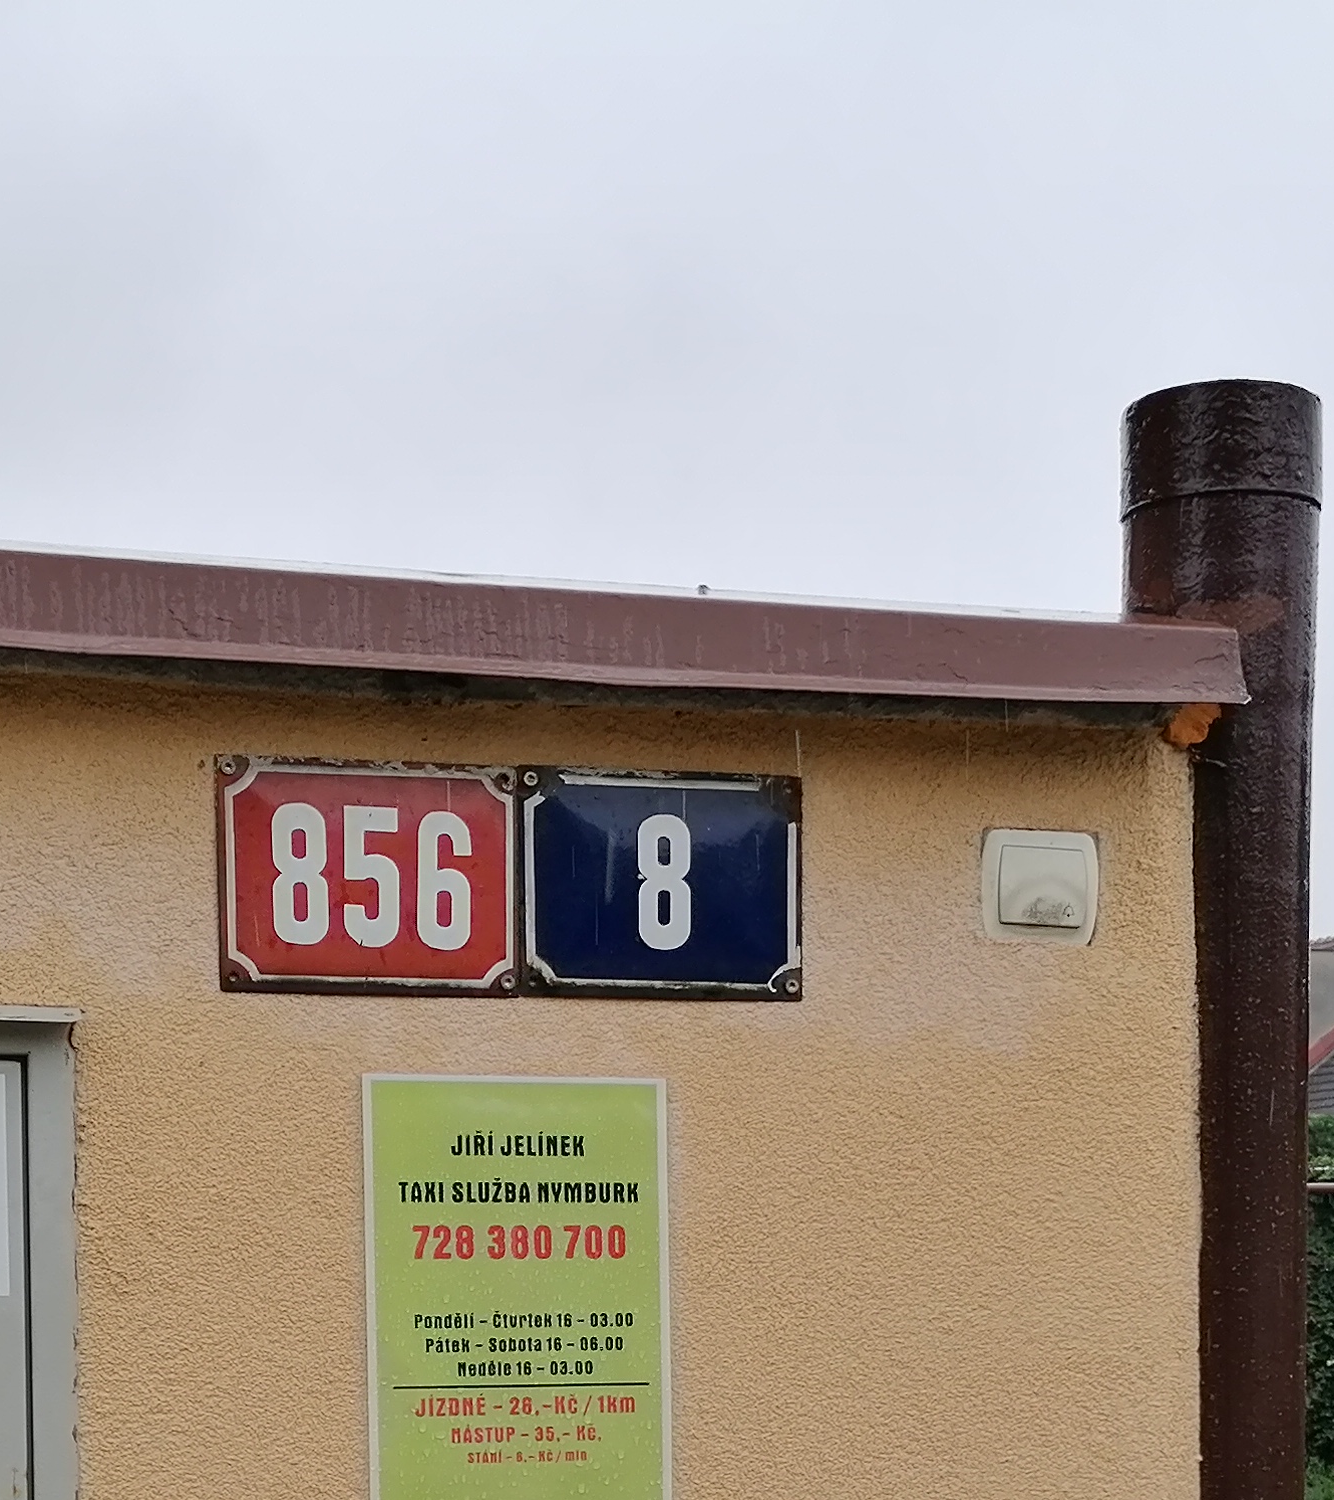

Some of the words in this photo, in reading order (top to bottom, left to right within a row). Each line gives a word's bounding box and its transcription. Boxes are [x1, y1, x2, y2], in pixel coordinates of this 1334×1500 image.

[271, 802, 473, 951] 856
[637, 814, 692, 951] 8
[450, 1130, 494, 1157] JIŘÍ
[500, 1131, 585, 1157] JELÍNEK
[398, 1181, 444, 1203] TAXI
[451, 1177, 531, 1204] SLUŽBA
[537, 1181, 640, 1204] NYMBURK
[412, 1224, 475, 1260] 728
[487, 1224, 552, 1260] 380
[563, 1224, 627, 1260] 700
[414, 1313, 475, 1329] Pondělí
[492, 1310, 552, 1329] Čtvrtek
[556, 1313, 573, 1328] 16
[590, 1312, 634, 1328] 03.00
[425, 1337, 470, 1353] Pátek
[488, 1337, 543, 1352] Sobota
[546, 1336, 563, 1352] 16
[458, 1360, 512, 1377] Neděle
[516, 1361, 532, 1376] 16
[550, 1360, 594, 1376] 03.00
[415, 1393, 486, 1417] JÍZDNÉ
[451, 1424, 516, 1443] NÁSTUP
[467, 1450, 502, 1463] STÁNÍ
